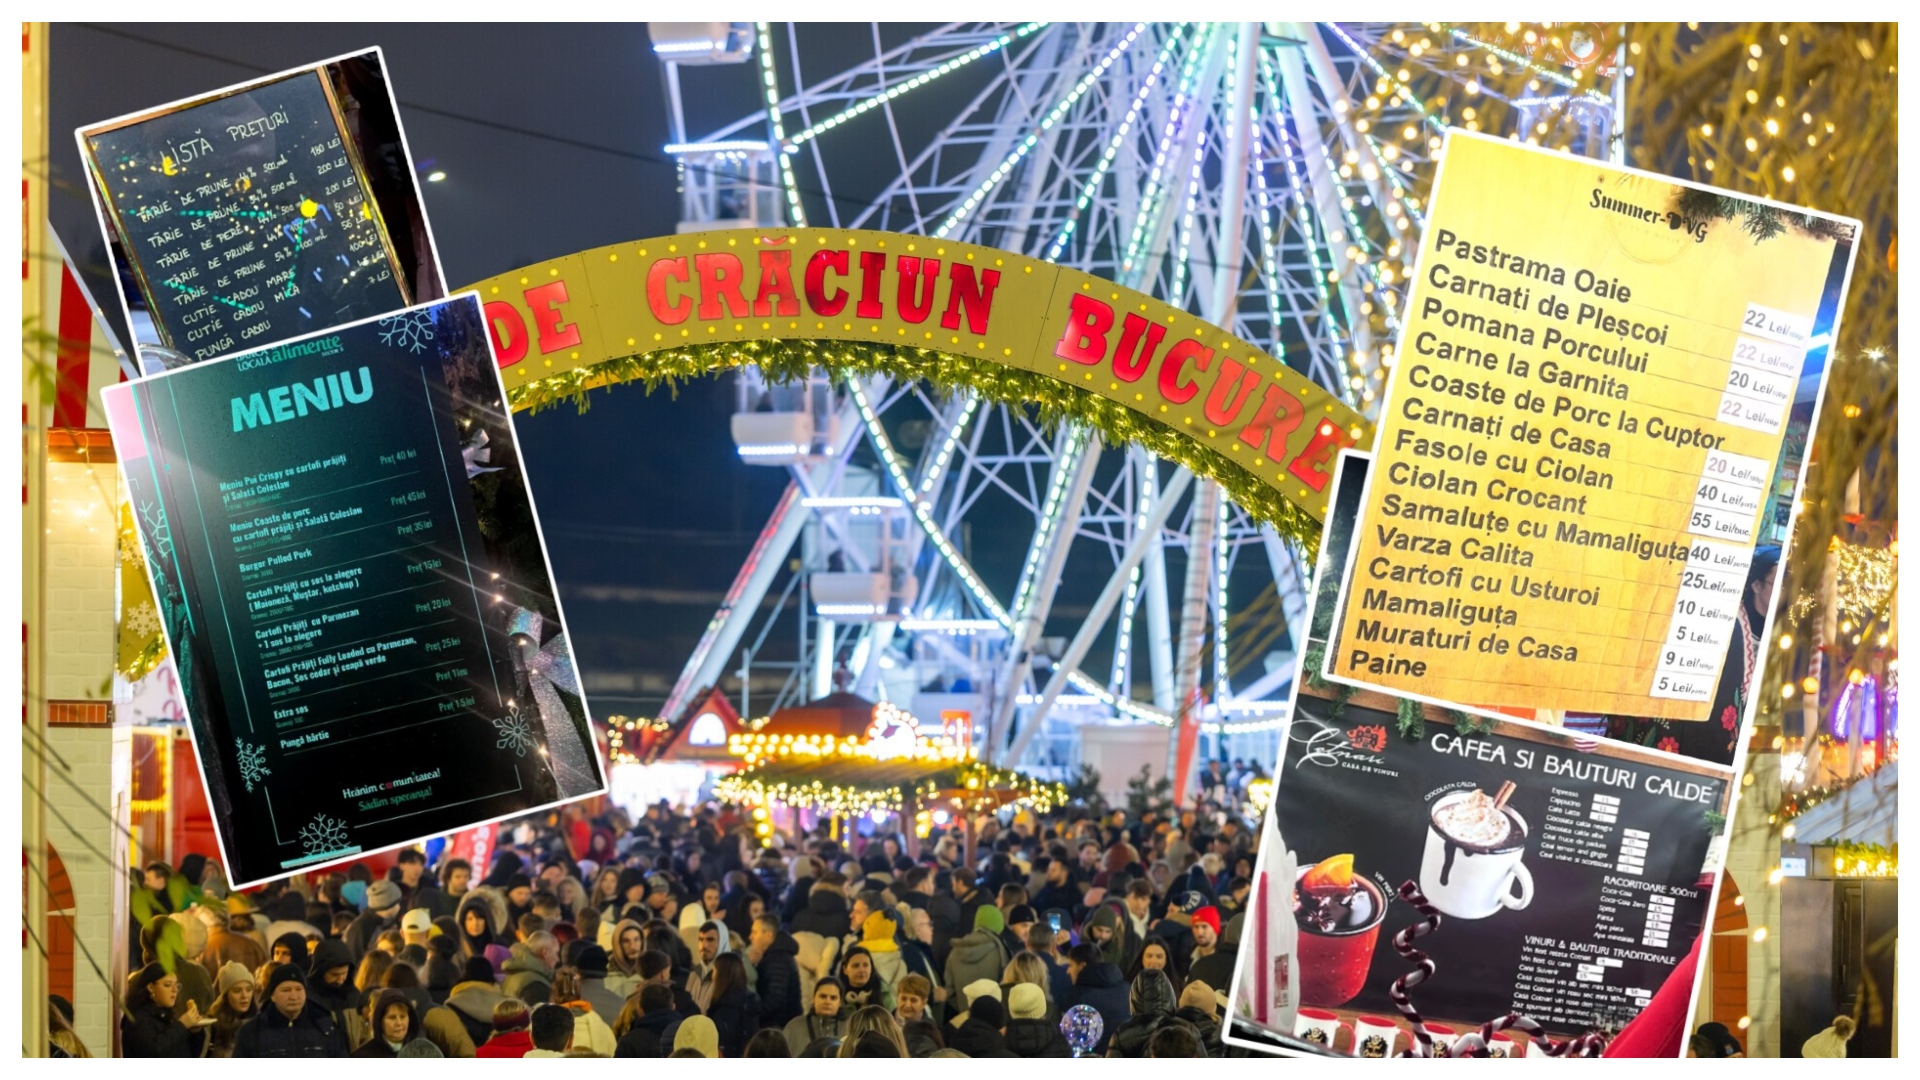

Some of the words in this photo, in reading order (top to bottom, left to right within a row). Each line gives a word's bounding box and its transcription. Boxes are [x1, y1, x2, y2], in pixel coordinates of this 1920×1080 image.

[180, 191, 196, 207] DE
[195, 177, 232, 198] PRUNE
[190, 218, 206, 231] DE
[205, 202, 241, 223] PRUNE
[317, 162, 332, 175] 200
[200, 238, 214, 251] DE
[325, 182, 340, 196] 200
[207, 256, 222, 270] DE
[223, 240, 255, 262] PRUNE
[1435, 228, 1566, 286] Pastrama
[1574, 268, 1631, 304] Oaie
[216, 275, 231, 288] DE
[233, 259, 266, 279] PRUNE
[646, 235, 1000, 336] CRĂCIUN
[225, 285, 259, 306] CADOU
[1428, 263, 1531, 311] Carnați
[1537, 294, 1569, 321] de
[1576, 302, 1669, 346] Pleșcoi
[233, 300, 265, 321] CADOU
[1744, 309, 1766, 329] 22
[241, 319, 271, 340] CADOU
[1422, 296, 1535, 346] Pomana
[1542, 327, 1649, 374] Porcului
[271, 335, 344, 363] alimente
[1736, 343, 1757, 361] 22
[1415, 331, 1499, 371] Carne
[1506, 352, 1530, 379] la
[1538, 360, 1629, 401] Garnita
[1728, 370, 1749, 389] 20
[230, 366, 374, 433] MENIU
[1409, 364, 1506, 406] Coaste
[1514, 389, 1546, 414] de
[1552, 395, 1611, 428] Porc
[1617, 410, 1639, 434] la
[1645, 416, 1726, 450] Cuptor
[1721, 399, 1743, 418] 22
[1402, 397, 1504, 440] Carnați
[1510, 420, 1542, 445] de
[1550, 427, 1611, 459] Casa
[1394, 428, 1488, 467] Fasole
[1495, 454, 1528, 474] cu
[1535, 455, 1614, 490] Ciolan
[1707, 456, 1728, 474] 20
[1388, 461, 1478, 497] Ciolan
[1486, 478, 1587, 516] Crocant
[1697, 484, 1718, 501] 40
[229, 521, 253, 533] Meniu
[253, 514, 281, 527] Coaste
[281, 511, 292, 521] de
[292, 507, 311, 520] porc
[232, 535, 243, 544] cu
[243, 527, 270, 541] cartofi
[329, 507, 363, 521] Coleslaw
[1381, 493, 1509, 540] Samaluțe
[1517, 519, 1548, 539] cu
[1554, 520, 1691, 565] Mamaliguța
[1691, 511, 1712, 529] 55
[238, 560, 266, 573] Burger
[267, 552, 293, 566] Pulled
[292, 548, 313, 560] Pork
[1376, 524, 1452, 556] Varza
[1460, 537, 1534, 568] Calita
[1690, 545, 1711, 562] 40
[1368, 555, 1464, 590] Cartofi
[1470, 575, 1502, 594] cu
[1510, 575, 1601, 606] Usturoi
[1362, 587, 1518, 629] Mamaliguța
[1677, 599, 1696, 615] 10
[1355, 618, 1473, 651] Muraturi
[1478, 632, 1510, 655] de
[1517, 636, 1578, 662] Casa
[1676, 625, 1687, 641] 5
[264, 665, 291, 679] Cartofi
[317, 654, 337, 666] Fully
[337, 646, 365, 661] Loaded
[365, 646, 376, 654] cu
[293, 673, 309, 683] Sos
[364, 654, 387, 666] verde
[1349, 649, 1427, 678] Paine
[1665, 651, 1676, 665] 9
[1658, 676, 1669, 691] 5
[273, 709, 294, 720] Extra
[295, 705, 309, 715] sos
[1431, 733, 1506, 765] CAFEA
[1513, 749, 1535, 770] SI
[1543, 754, 1637, 790] BAUTURI
[1644, 775, 1713, 805] CALDE
[1603, 875, 1666, 894] RACORITOARE
[1669, 886, 1698, 898] 500ml
[1524, 935, 1556, 947] VINURI
[1558, 940, 1566, 949] &
[1569, 941, 1610, 956] BAUTURI
[1613, 948, 1676, 965] TRADITIONALE
